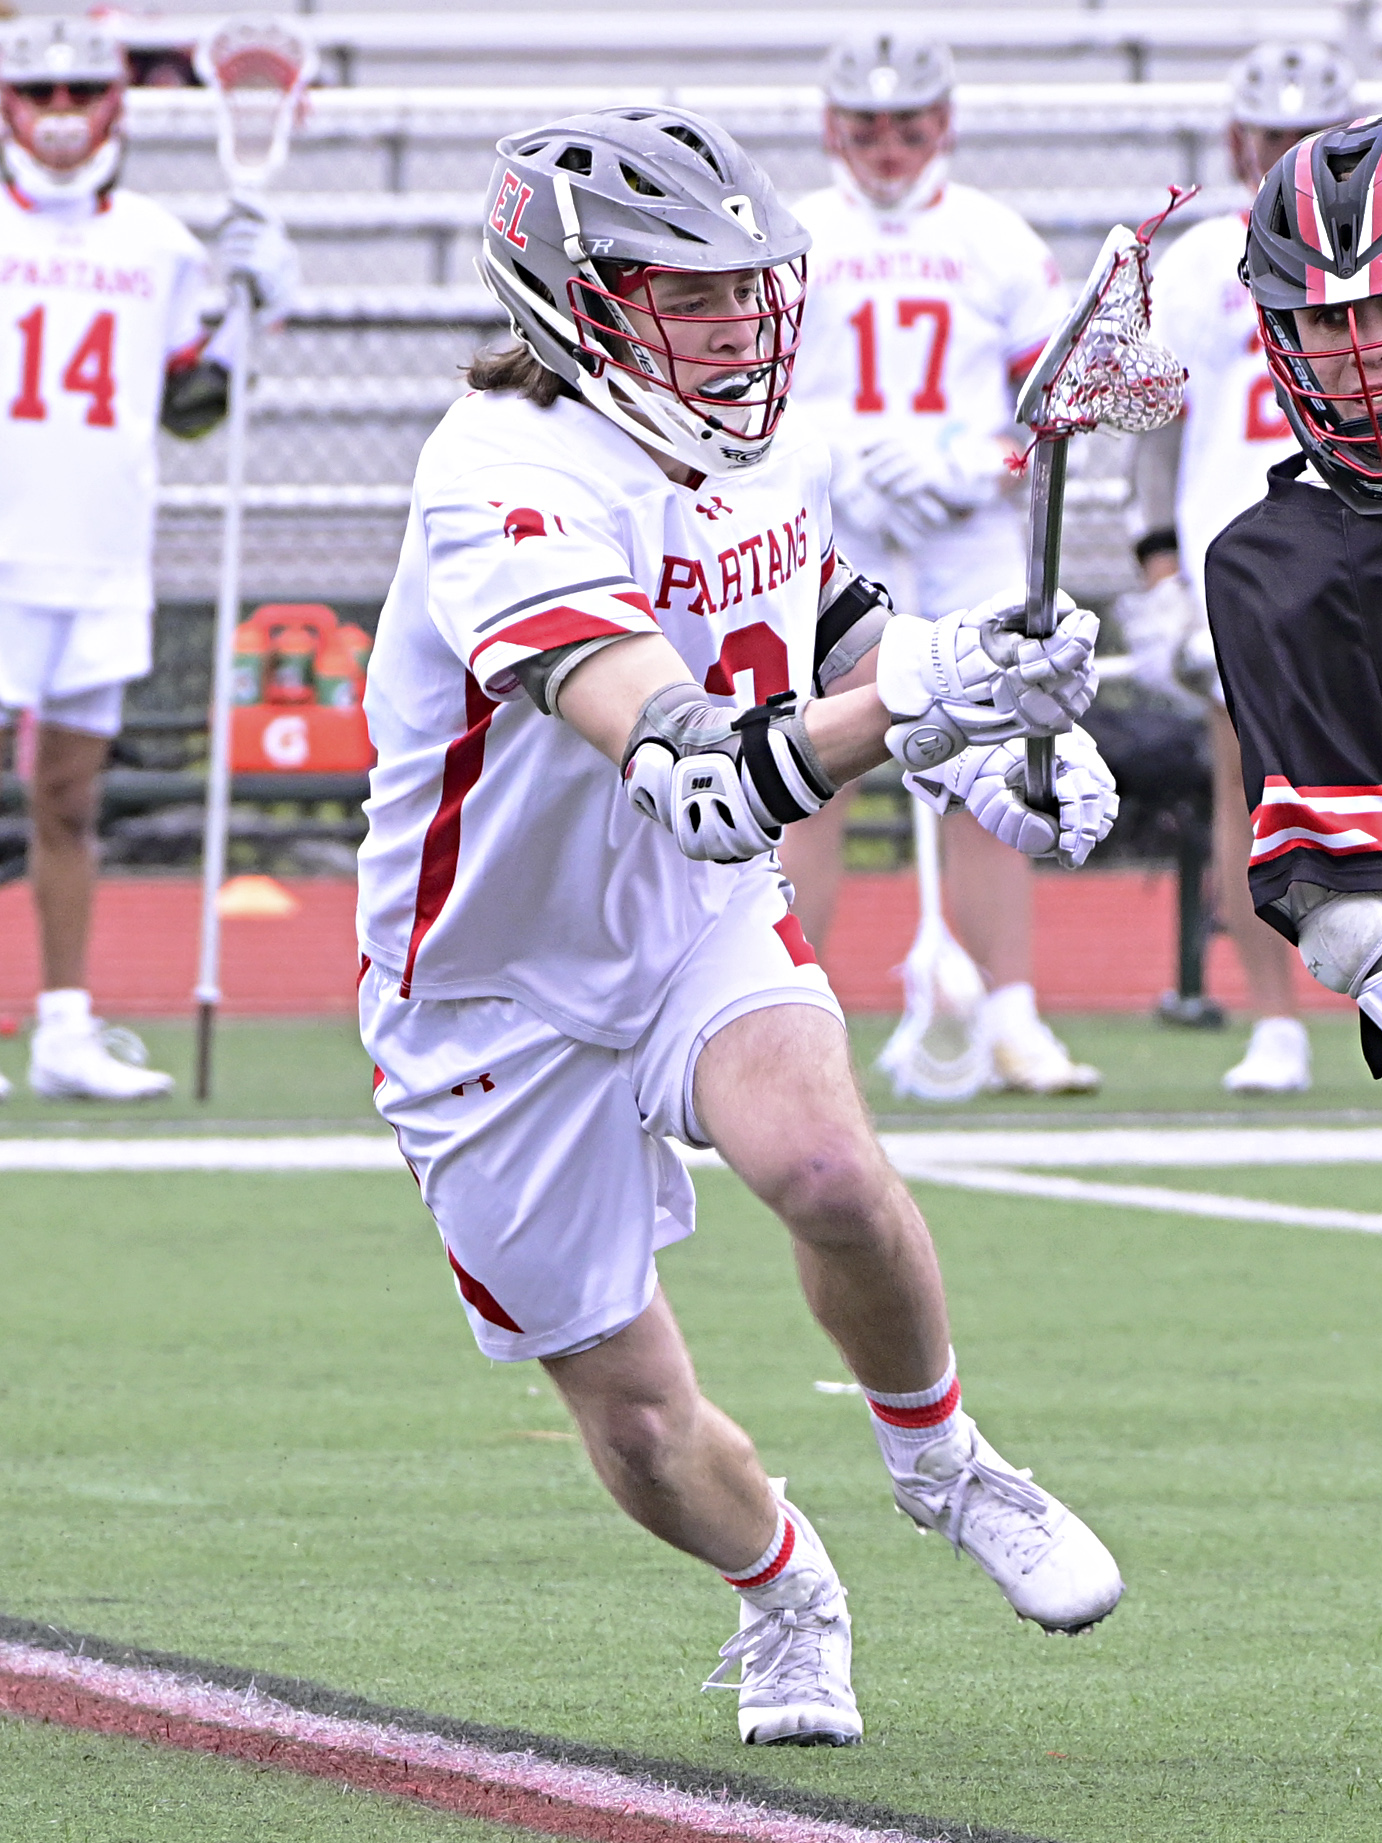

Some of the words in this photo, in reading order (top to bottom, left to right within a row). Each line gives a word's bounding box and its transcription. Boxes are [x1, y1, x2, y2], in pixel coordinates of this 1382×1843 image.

[489, 168, 534, 252] EL
[0, 255, 154, 299] PARTANS
[9, 303, 116, 429] 14
[849, 299, 951, 413] 17
[654, 506, 807, 617] PARTANS
[262, 714, 310, 769] G
